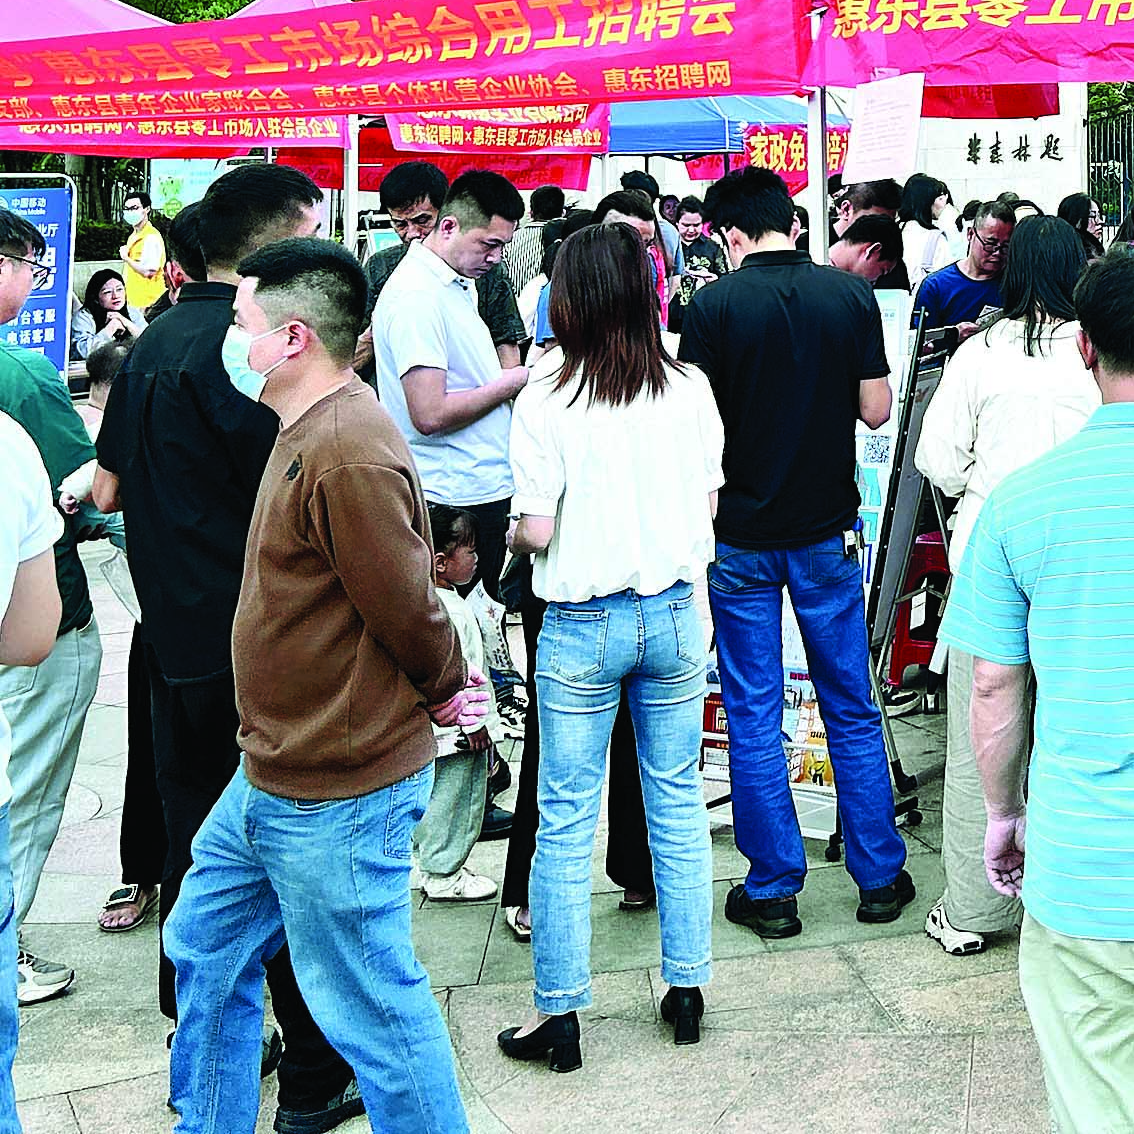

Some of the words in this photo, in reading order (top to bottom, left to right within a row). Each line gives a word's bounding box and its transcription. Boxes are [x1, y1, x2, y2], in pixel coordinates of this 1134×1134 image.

[750, 131, 850, 172] 家政免培
[12, 197, 47, 208] 中国移动
[36, 223, 59, 237] 业厅
